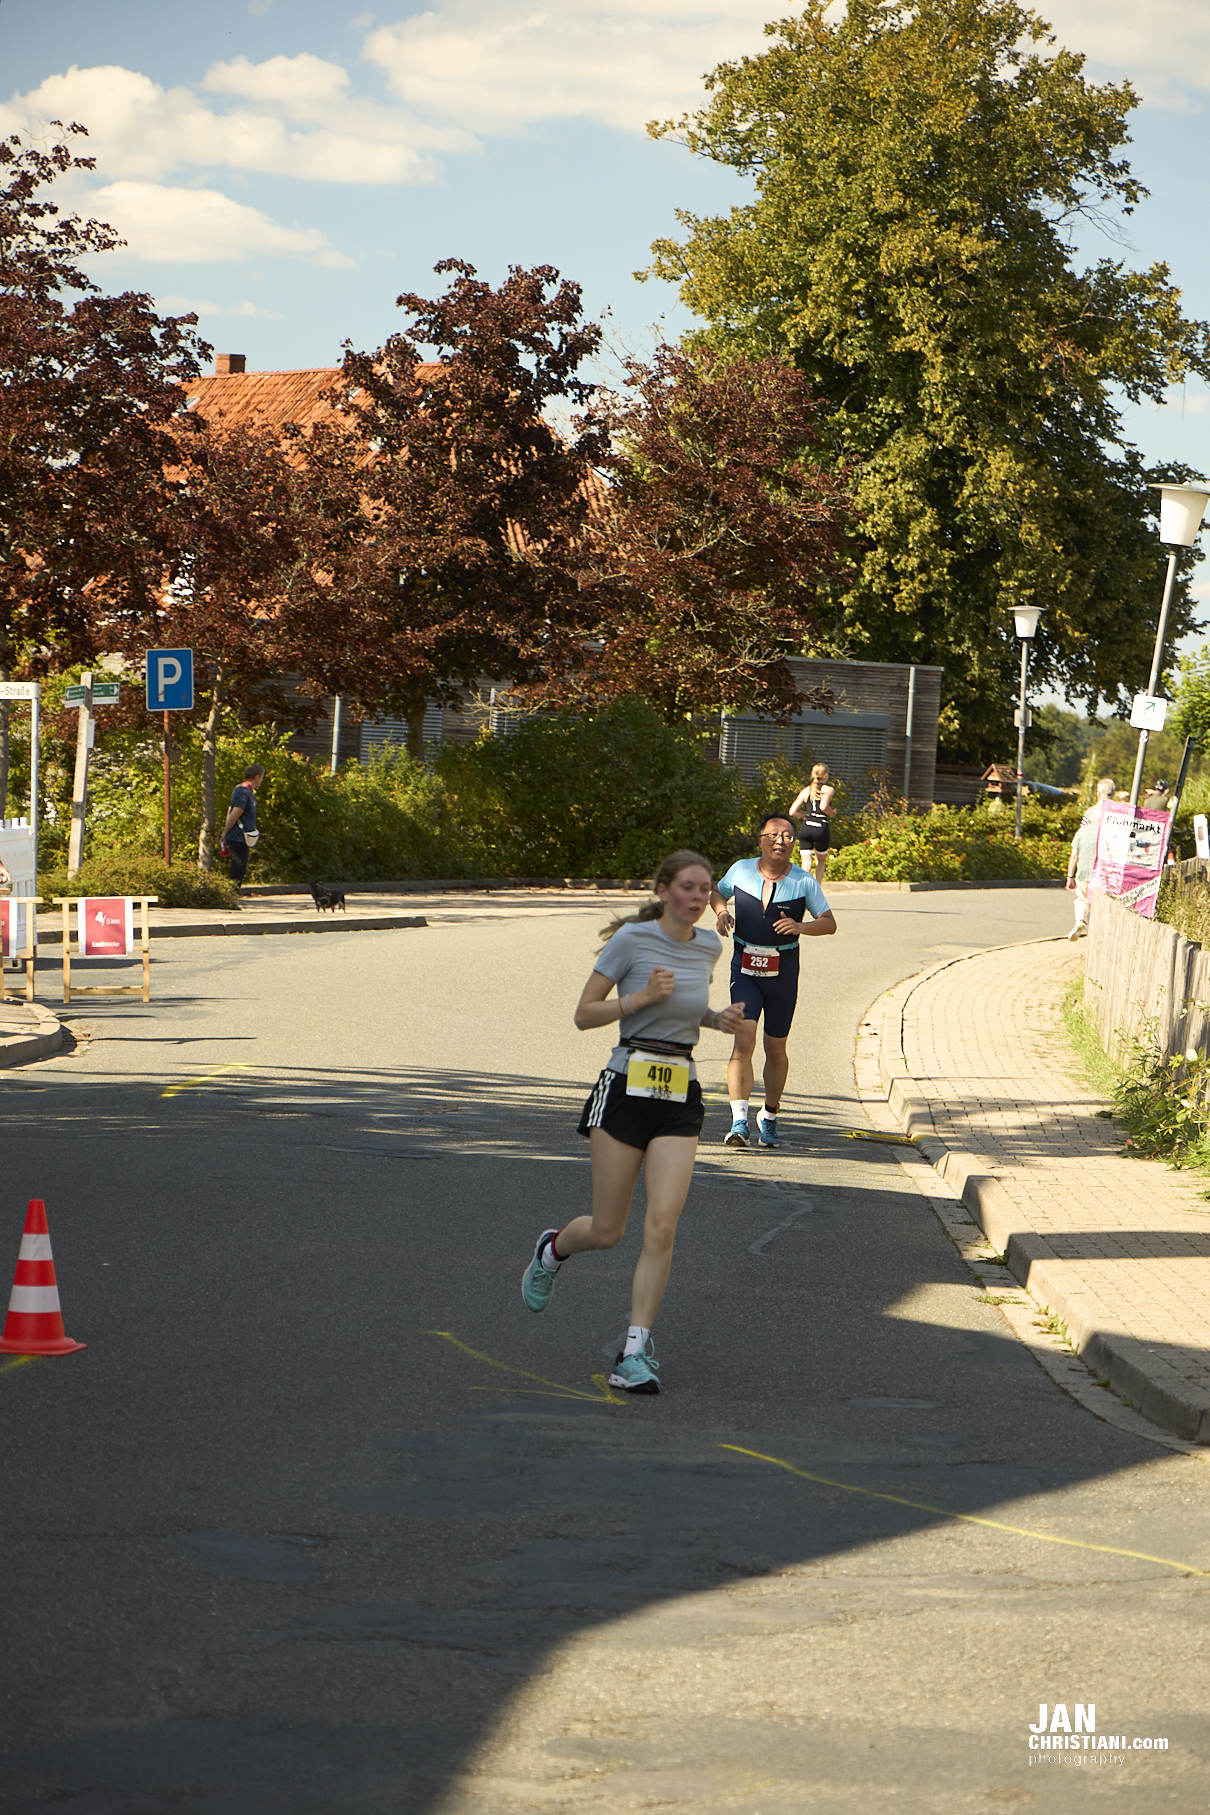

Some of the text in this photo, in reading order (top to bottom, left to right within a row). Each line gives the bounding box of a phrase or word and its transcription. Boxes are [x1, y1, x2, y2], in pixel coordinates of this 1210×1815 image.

[157, 657, 182, 702] P
[750, 955, 769, 968] 252
[647, 1065, 672, 1084] 410
